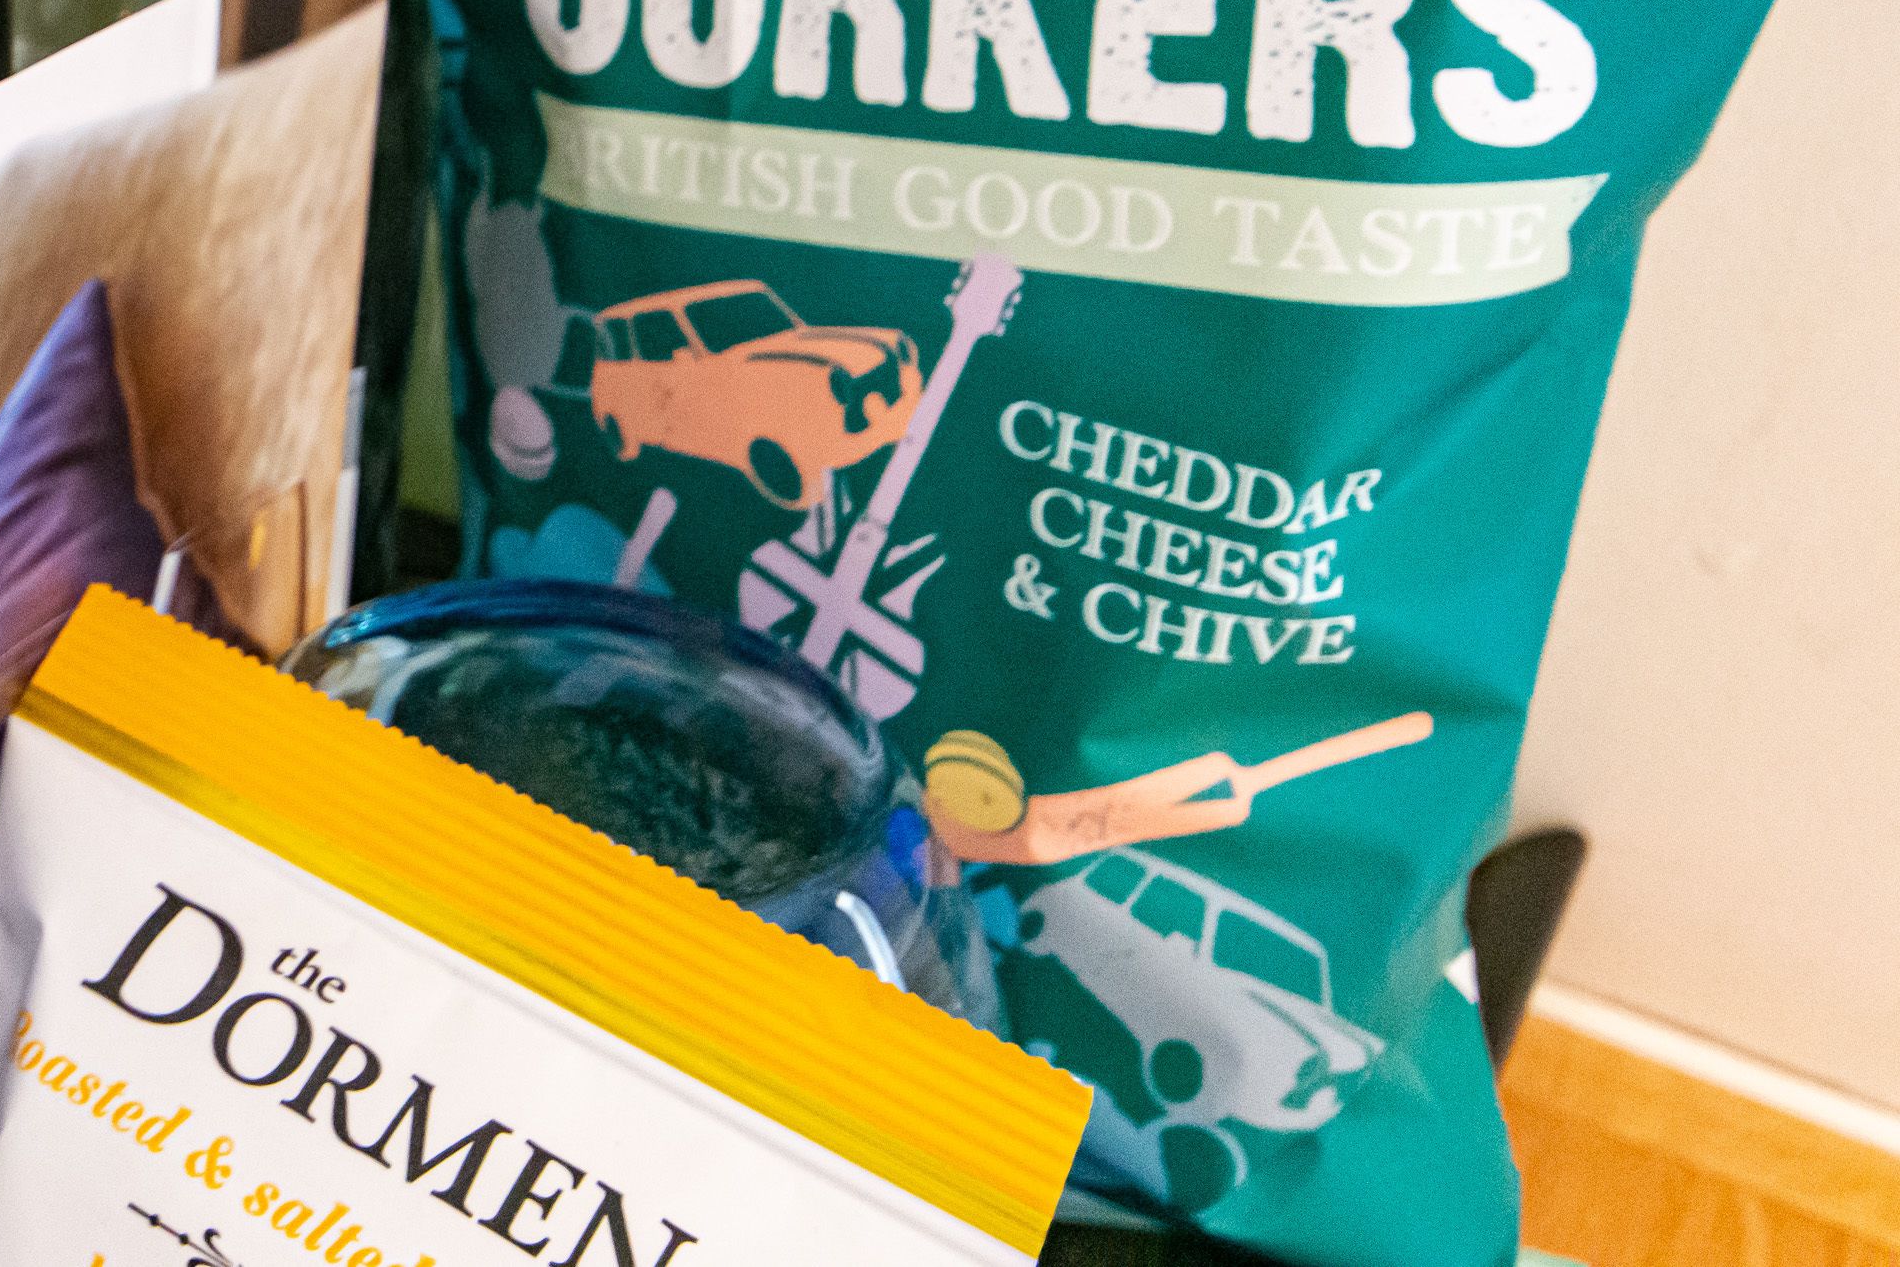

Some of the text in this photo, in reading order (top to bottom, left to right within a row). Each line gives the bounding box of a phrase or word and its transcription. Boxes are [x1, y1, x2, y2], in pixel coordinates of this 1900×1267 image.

[570, 122, 1548, 280] RITISH GOOD TASTE
[998, 399, 1382, 534] CHEDDAR
[1003, 553, 1357, 665] & CHIVE
[1028, 486, 1345, 607] CHEESE
[268, 946, 348, 1005] the
[79, 881, 700, 1267] DORMEN
[183, 1136, 236, 1191] &
[242, 1178, 436, 1267] salte
